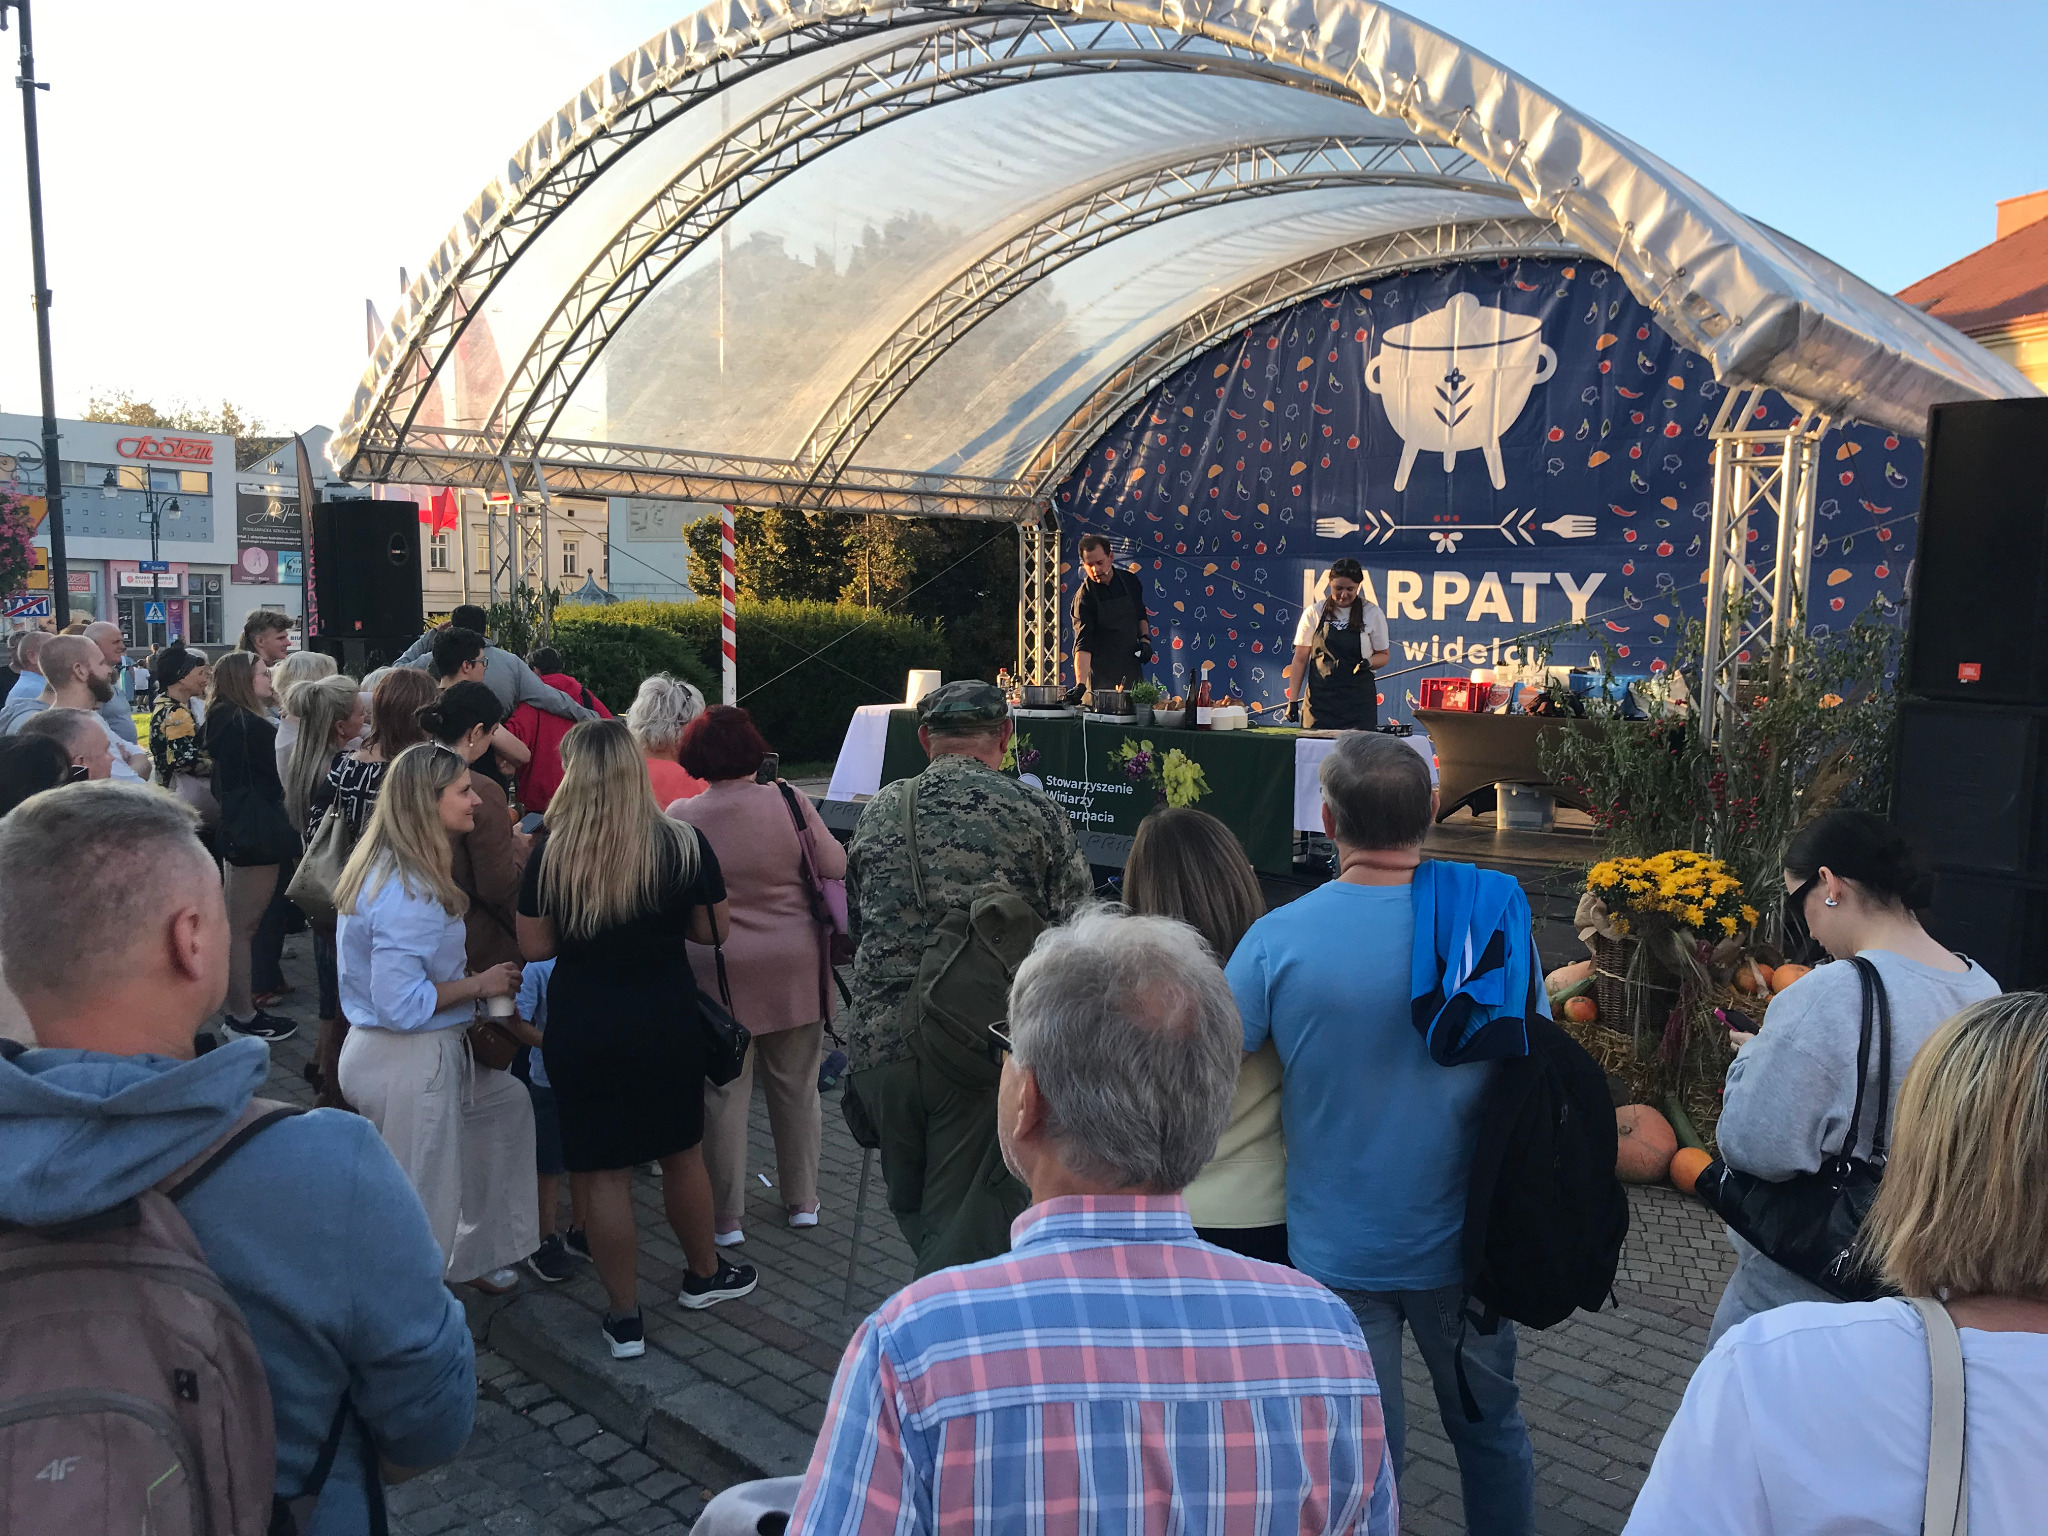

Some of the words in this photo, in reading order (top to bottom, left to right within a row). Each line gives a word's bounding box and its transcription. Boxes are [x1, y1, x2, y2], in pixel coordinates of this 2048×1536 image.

[1402, 634, 1546, 666] widelcu
[1046, 775, 1134, 794] Stowarzyszenie
[1045, 789, 1094, 808] Winiarzy
[1066, 810, 1114, 822] arpacia
